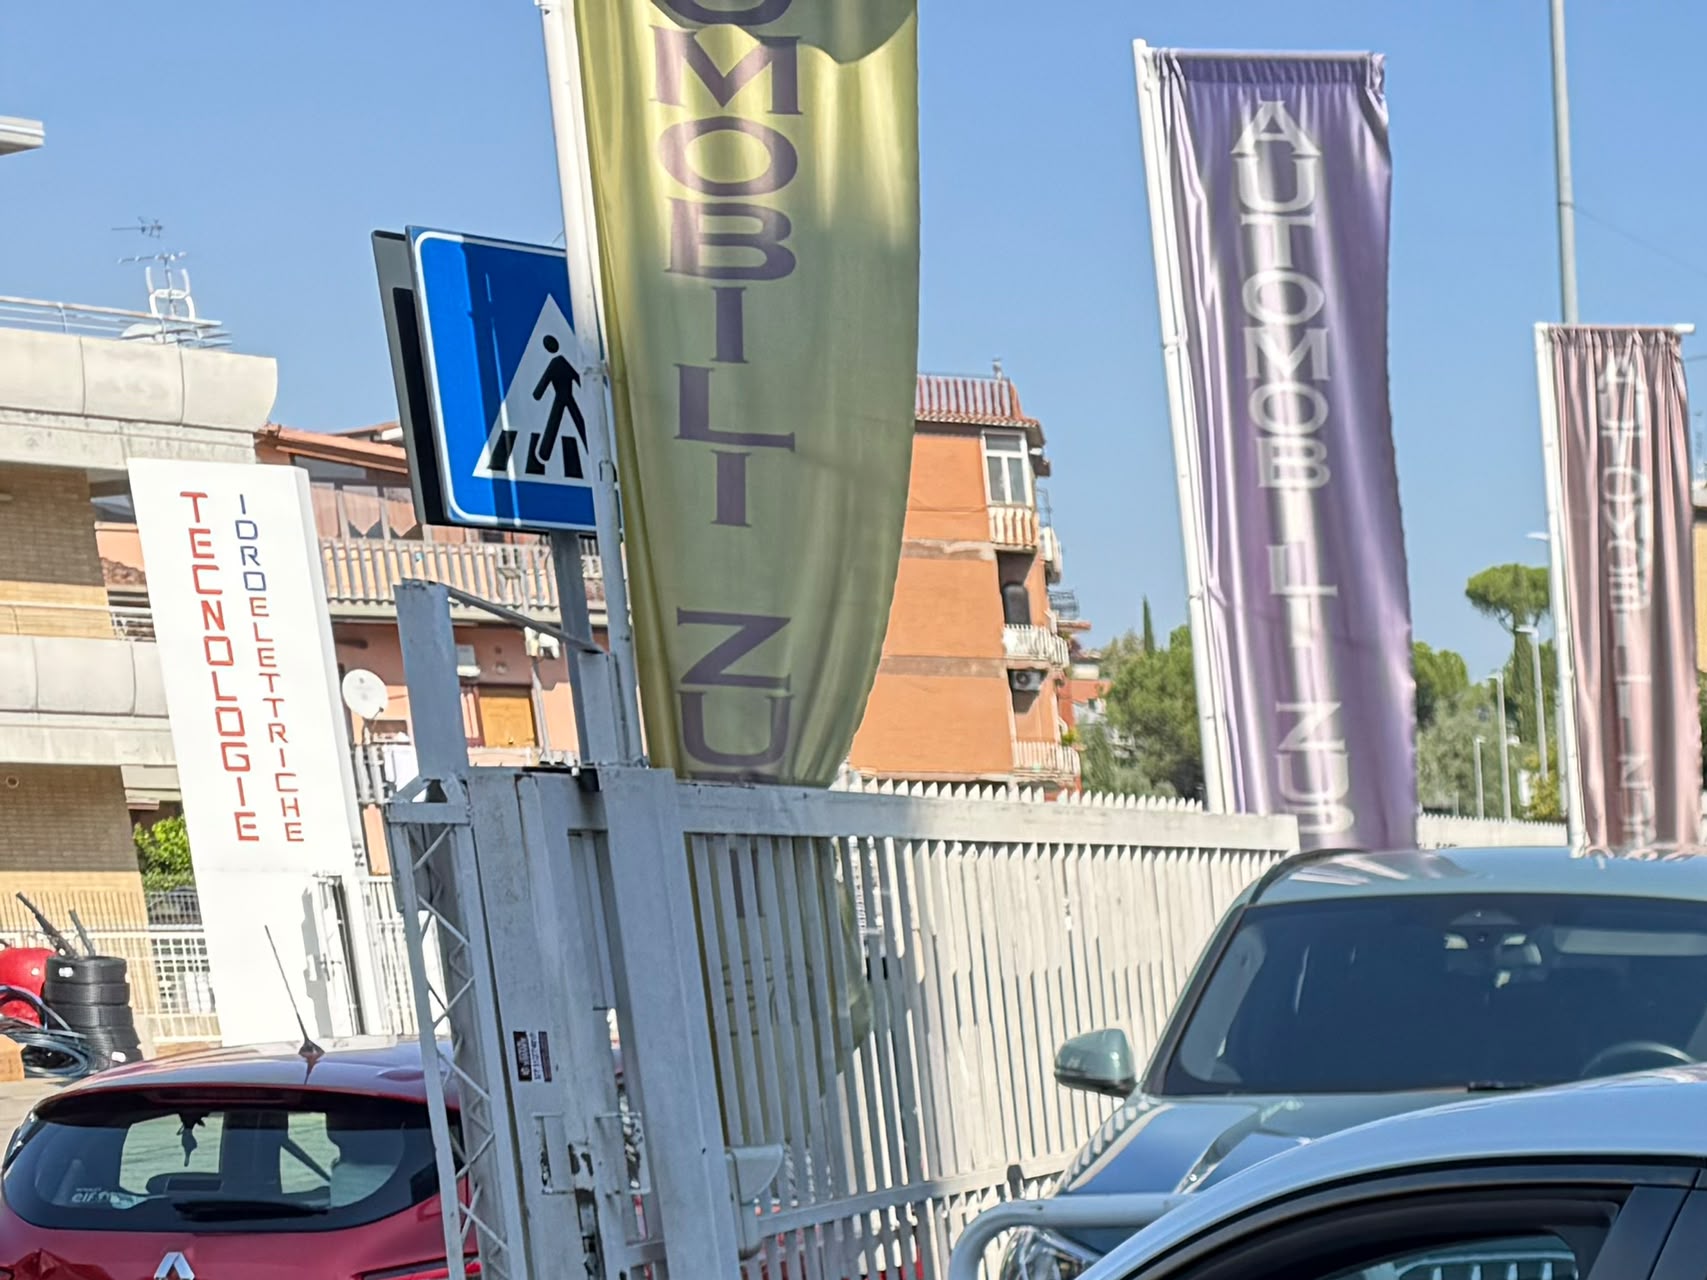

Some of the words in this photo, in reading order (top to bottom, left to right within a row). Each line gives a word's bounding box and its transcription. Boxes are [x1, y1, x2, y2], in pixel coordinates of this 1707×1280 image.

[1231, 99, 1338, 648] AUTOMOBILI
[180, 491, 260, 842] TECNOLOGIE
[235, 493, 304, 842] IDROELETTRICHE
[676, 607, 795, 787] ZU
